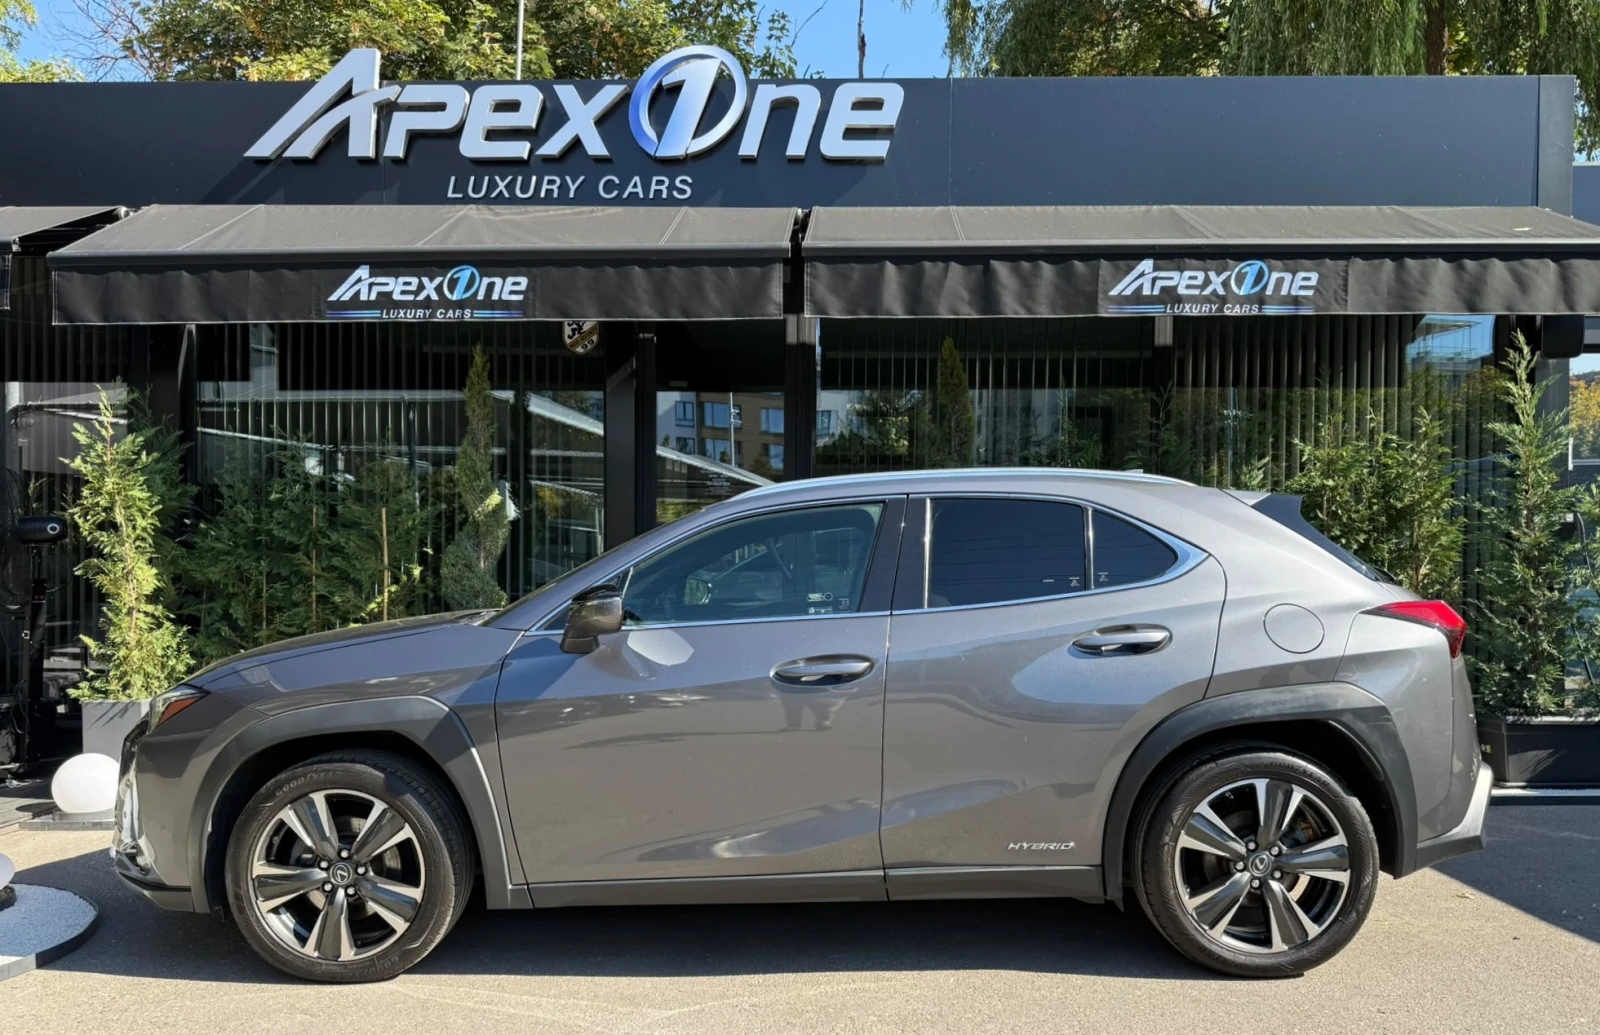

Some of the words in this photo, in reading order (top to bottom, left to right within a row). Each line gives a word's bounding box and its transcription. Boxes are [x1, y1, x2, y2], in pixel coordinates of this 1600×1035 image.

[447, 175, 586, 199] LUXURY
[598, 175, 693, 199] CARS
[382, 308, 432, 319] LUXURY
[436, 308, 472, 319] CARS
[1166, 303, 1219, 313] LUXURY
[1223, 304, 1260, 314] CARS
[580, 339, 595, 351] 99
[1007, 841, 1076, 850] HYBRID
